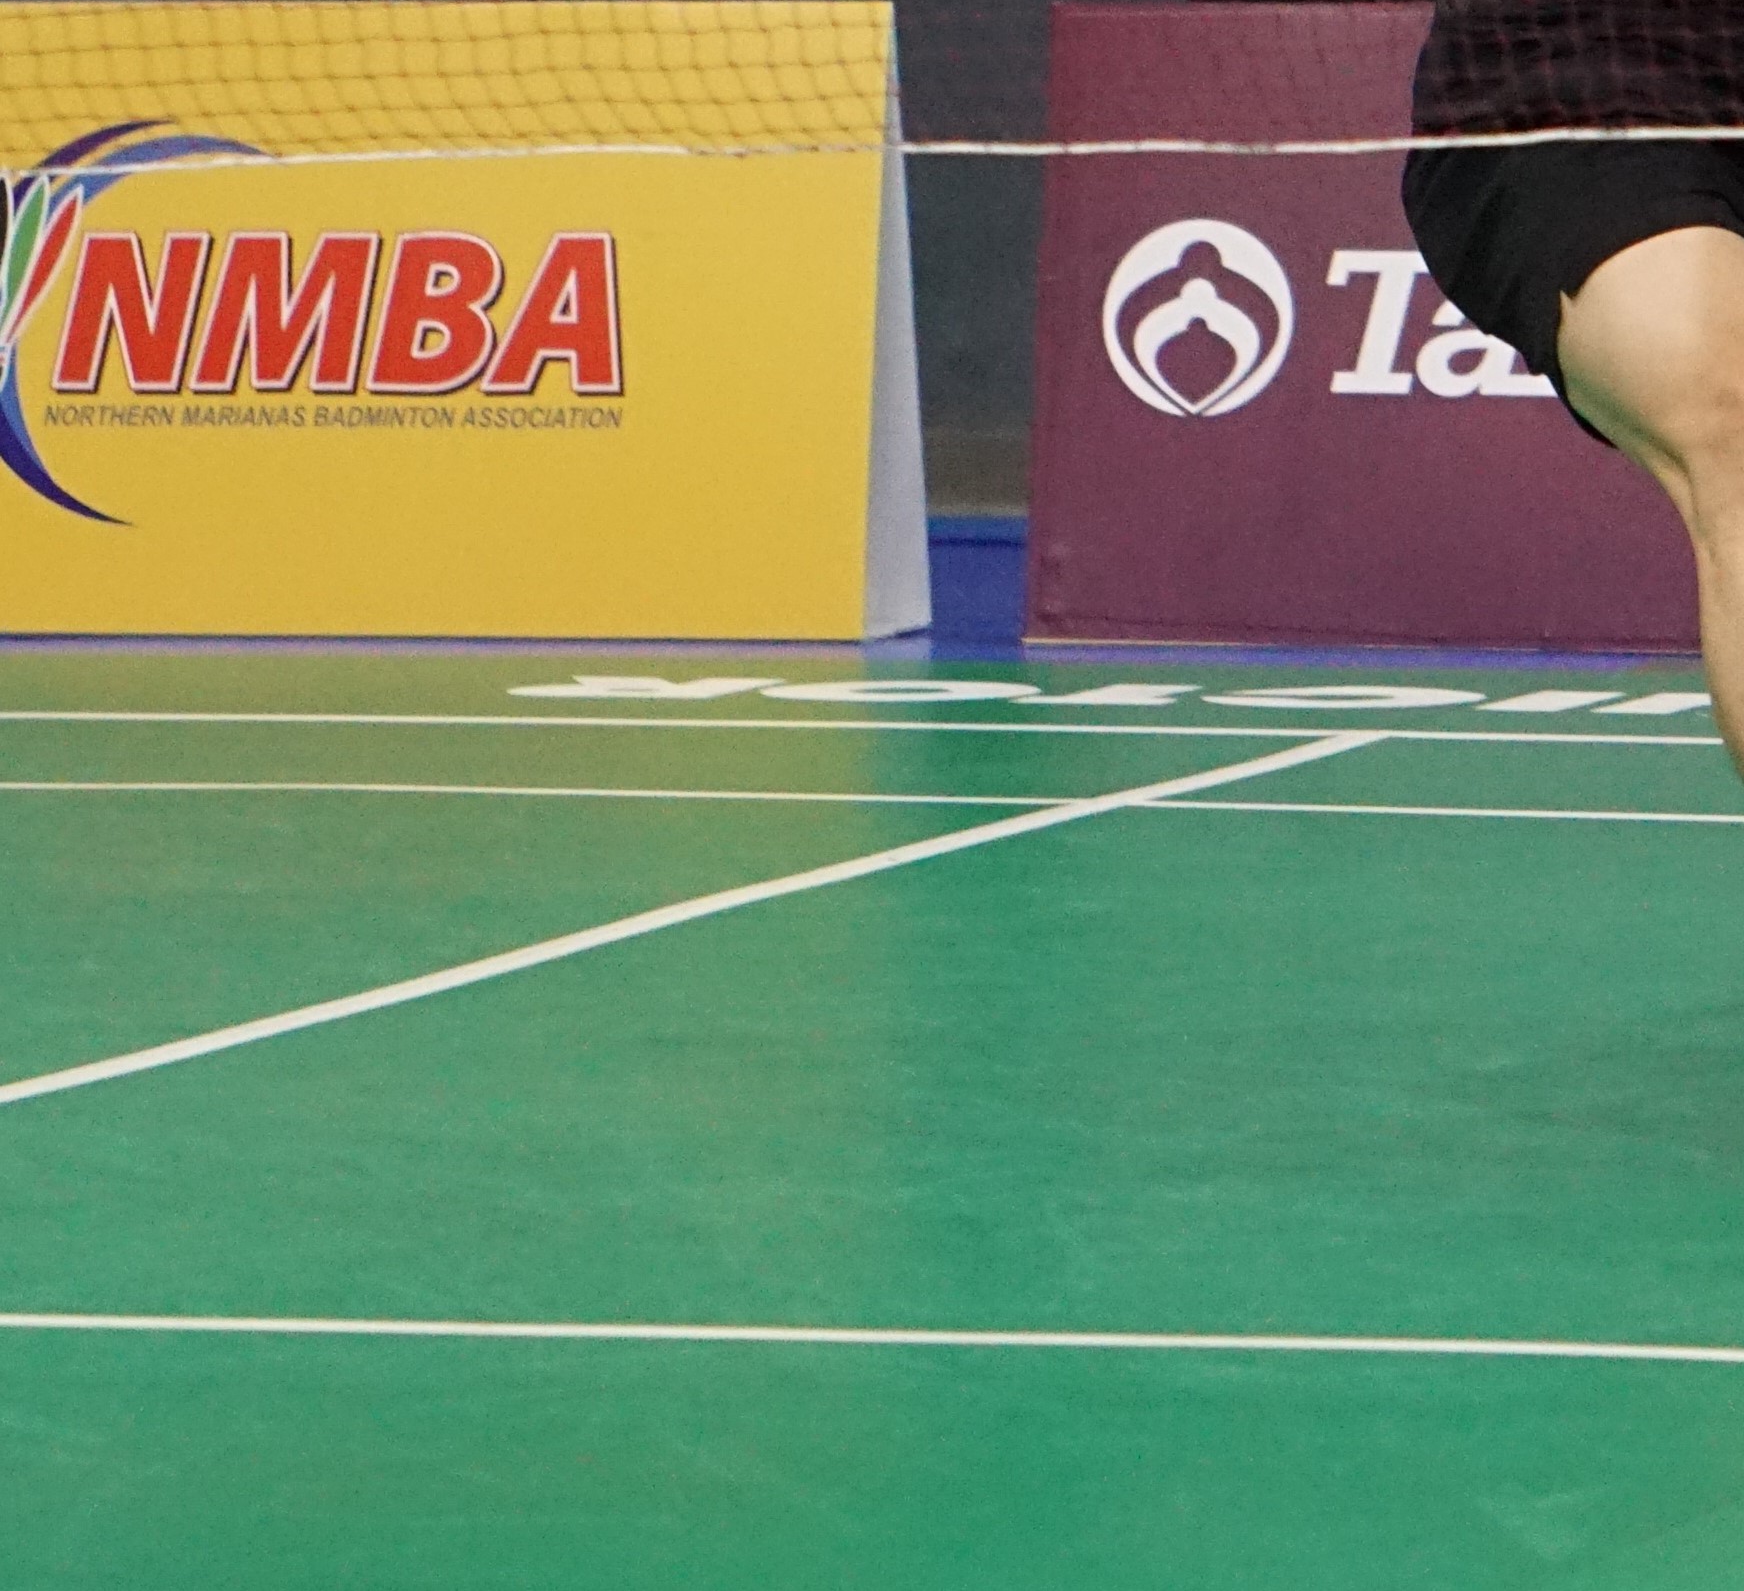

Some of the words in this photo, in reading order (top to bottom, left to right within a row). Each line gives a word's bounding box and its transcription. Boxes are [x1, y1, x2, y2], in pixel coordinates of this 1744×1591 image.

[52, 232, 624, 395] NMBA
[43, 404, 175, 427] NORTHERN
[180, 404, 306, 428] MARIANAS
[313, 404, 455, 429] BADMINTON
[460, 405, 623, 429] ASSOCIATION
